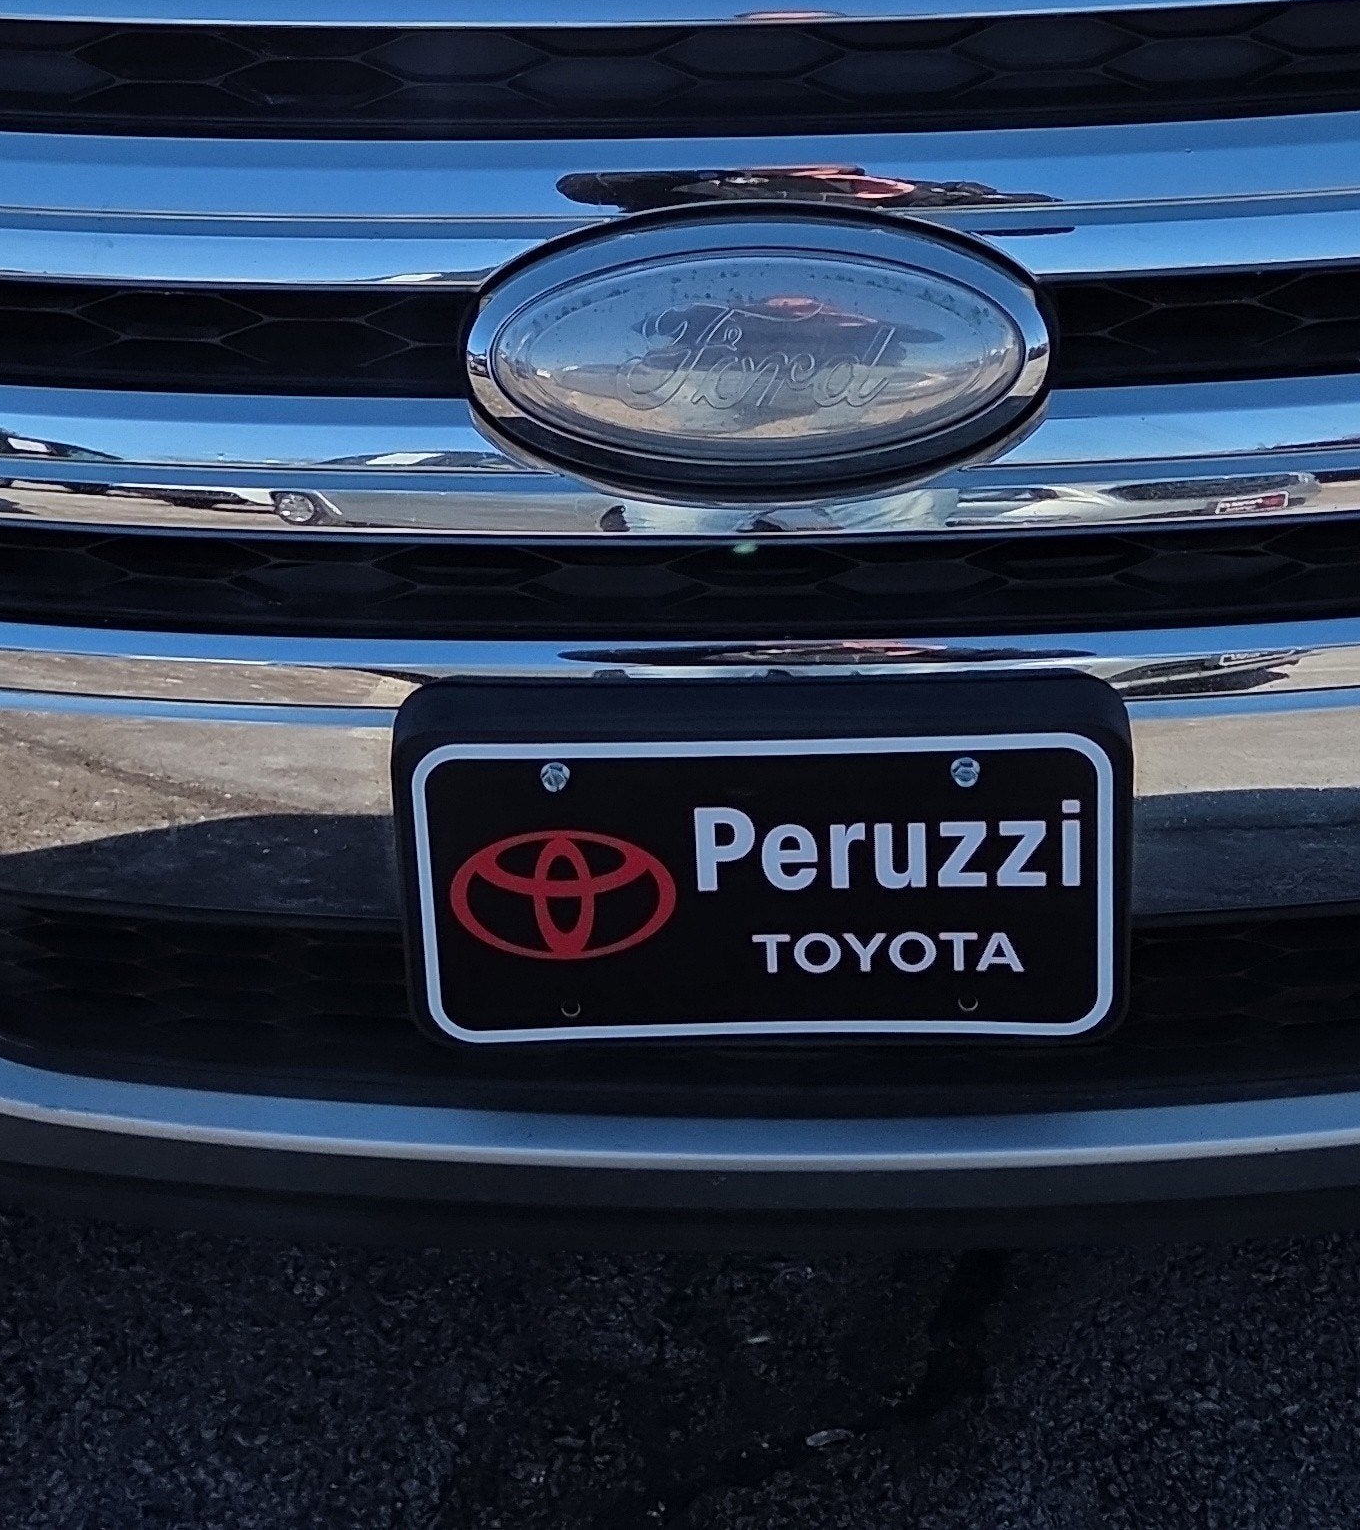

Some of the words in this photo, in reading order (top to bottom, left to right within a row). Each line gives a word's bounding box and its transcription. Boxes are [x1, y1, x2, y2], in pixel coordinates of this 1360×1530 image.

[617, 301, 897, 410] Ford
[693, 799, 1082, 892] Peruzzi
[751, 931, 1025, 974] TOYOTA
